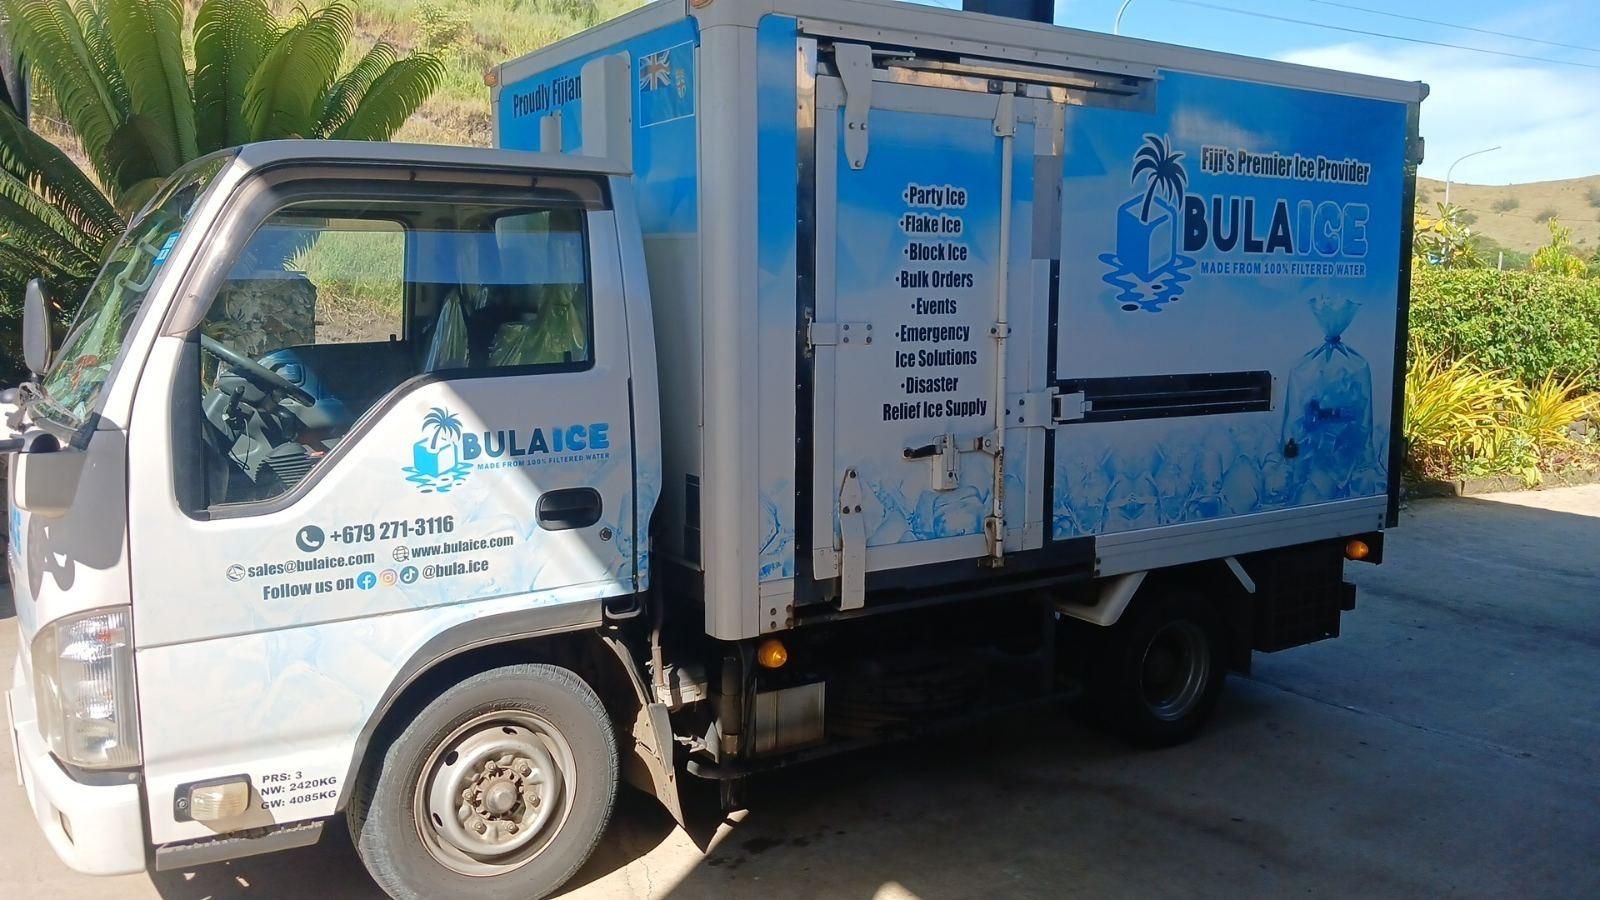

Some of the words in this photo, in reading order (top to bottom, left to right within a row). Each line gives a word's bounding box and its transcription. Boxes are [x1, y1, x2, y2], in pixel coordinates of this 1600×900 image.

[513, 84, 550, 118] Proudly
[552, 75, 582, 106] Fijian
[1201, 147, 1235, 173] Fiji's
[1238, 151, 1292, 177] Premier
[1294, 154, 1315, 178] Ice
[1318, 158, 1370, 183] Provider
[909, 186, 943, 206] Party
[945, 187, 966, 206] Ice
[905, 215, 938, 233] Flake
[941, 216, 961, 233] Ice
[909, 243, 945, 261] Block
[948, 243, 967, 261] Ice
[1200, 262, 1230, 274] MADE
[1233, 262, 1261, 275] FROM
[1264, 263, 1288, 275] 100%
[1291, 263, 1334, 275] FILTERED
[1336, 264, 1365, 276] WATER
[901, 270, 929, 288] Bulk
[932, 270, 973, 288] Orders
[916, 297, 957, 315] Events
[901, 324, 970, 343] Emergency
[895, 350, 915, 368] Ice
[918, 349, 977, 368] Solutions
[906, 376, 959, 394] Disaster
[883, 402, 921, 421] Relief
[923, 401, 943, 418] Ice
[945, 398, 987, 417] Supply
[477, 462, 500, 471] MADE
[502, 460, 525, 469] FROM
[527, 458, 546, 467] 100%
[549, 456, 584, 465] FILTERED
[586, 453, 610, 462] WATER
[330, 523, 375, 545] +679
[379, 515, 454, 541] 271-3116
[411, 535, 514, 559] www.bulaice.com
[247, 553, 375, 578] sales@bulaice.com
[422, 560, 489, 580] @bula.ice
[263, 582, 312, 601] Follow
[315, 580, 333, 594] us
[336, 577, 354, 591] on
[261, 785, 285, 796] NW:
[289, 776, 336, 792] 2420KG
[262, 773, 291, 783] PRS:
[295, 771, 302, 779] 3
[261, 799, 285, 809] GW:
[289, 790, 336, 804] 4085KG
